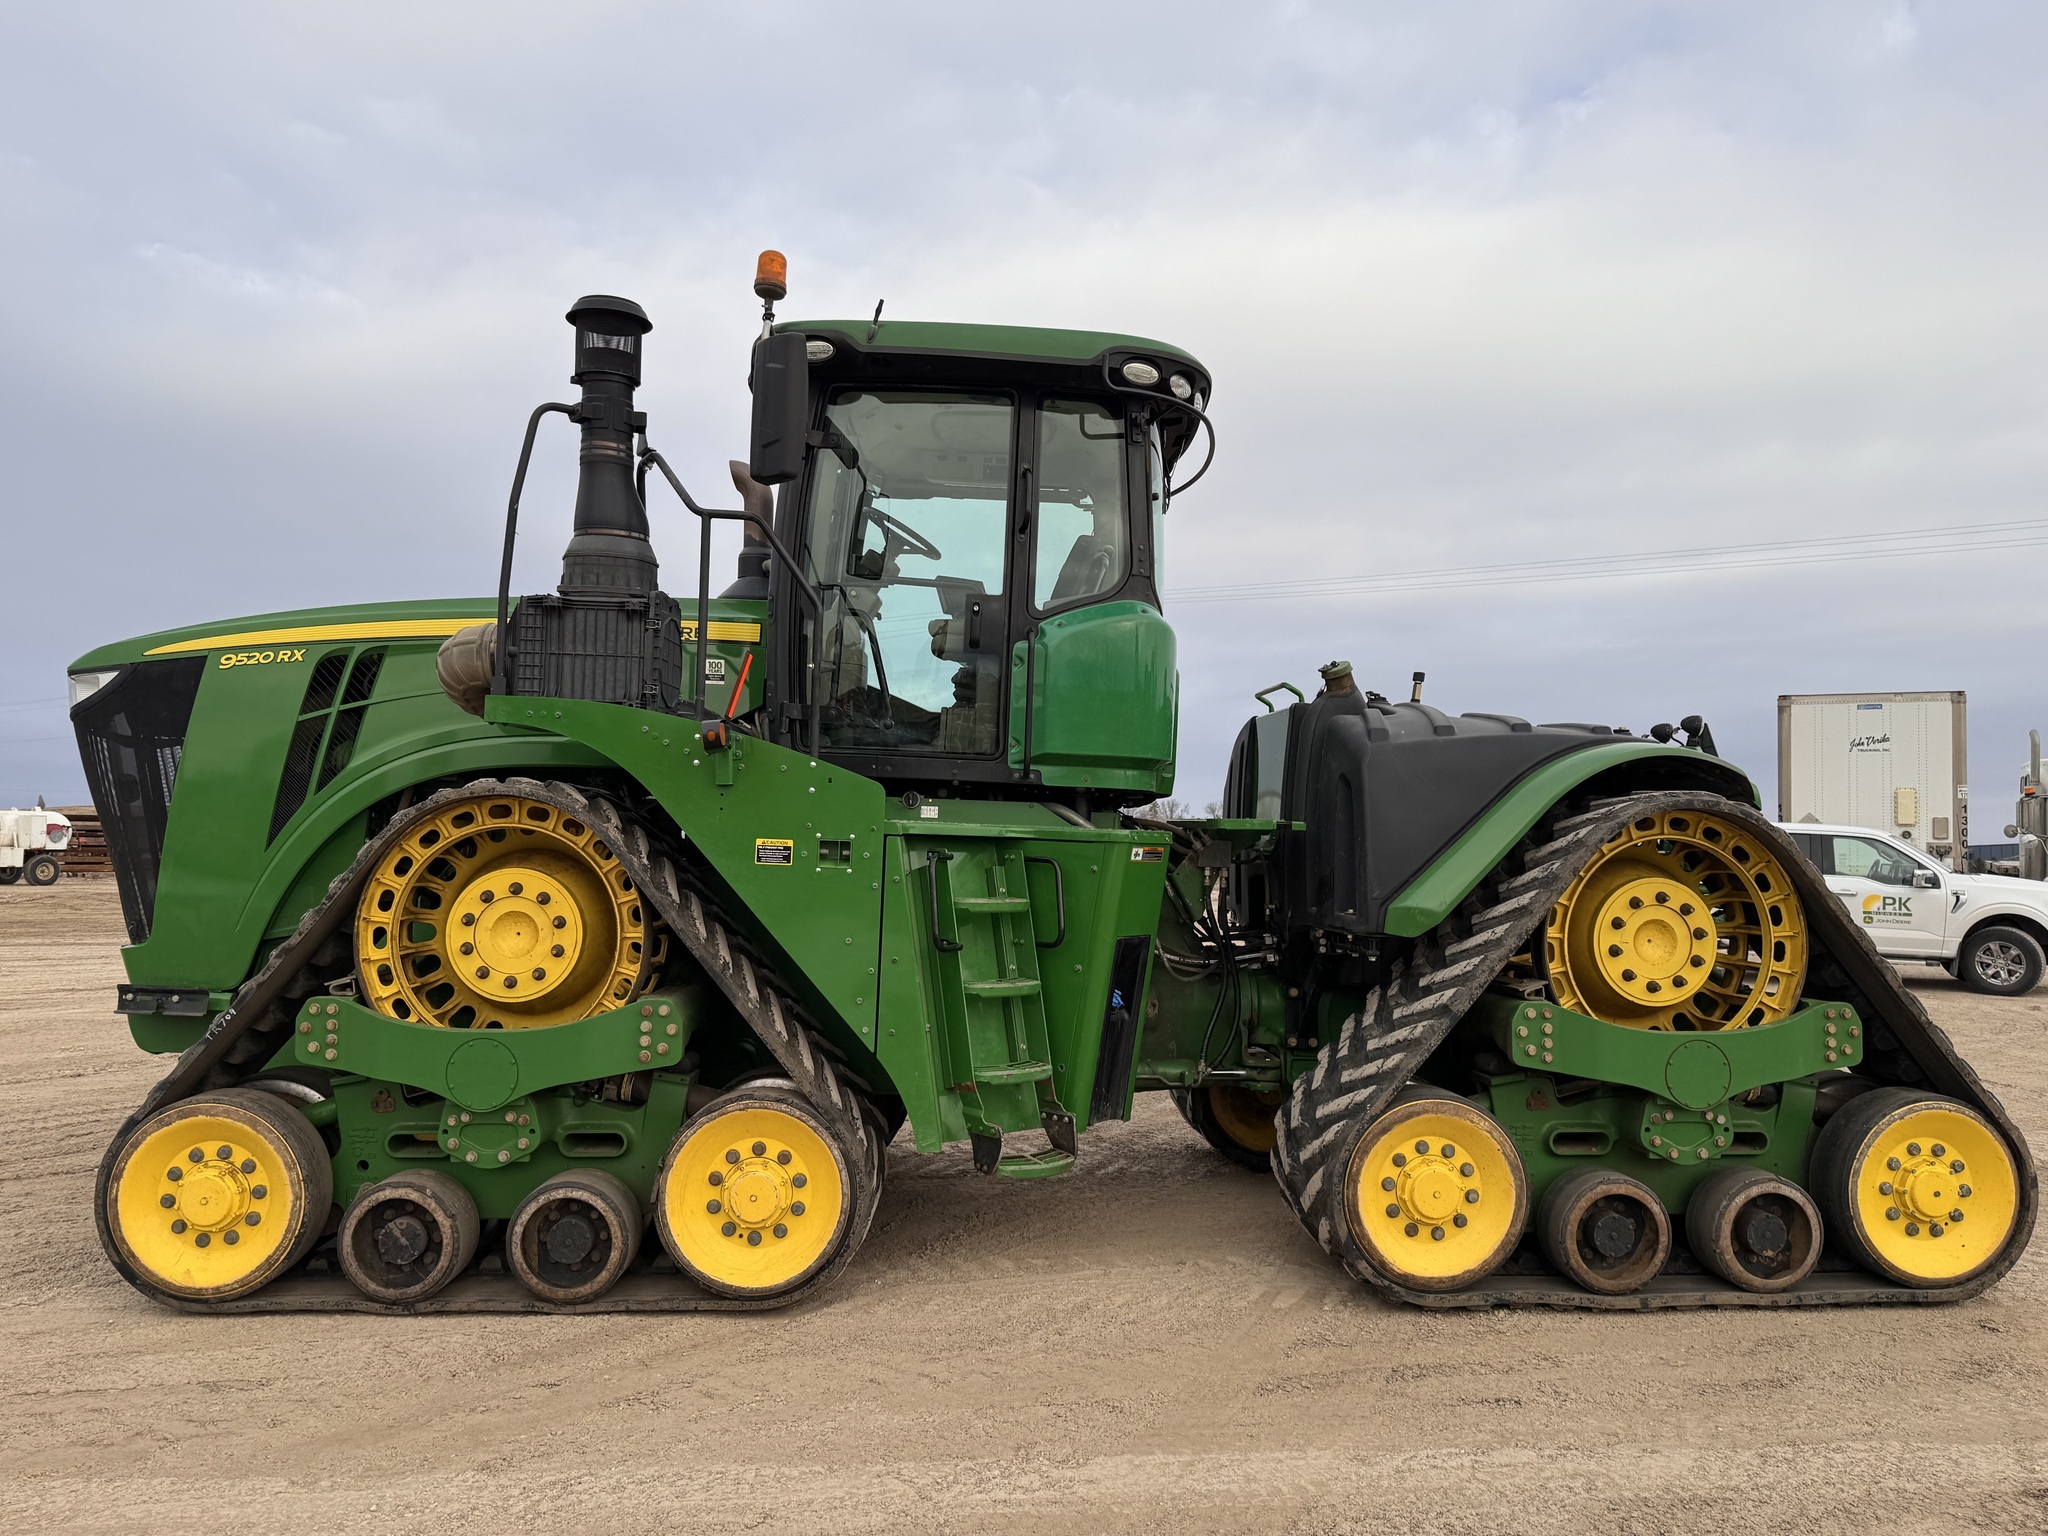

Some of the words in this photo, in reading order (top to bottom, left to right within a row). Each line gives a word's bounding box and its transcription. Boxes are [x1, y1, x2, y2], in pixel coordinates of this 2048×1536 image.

[218, 651, 275, 670] 9520
[276, 648, 307, 663] RX
[708, 661, 722, 669] 100
[1849, 736, 1865, 752] John
